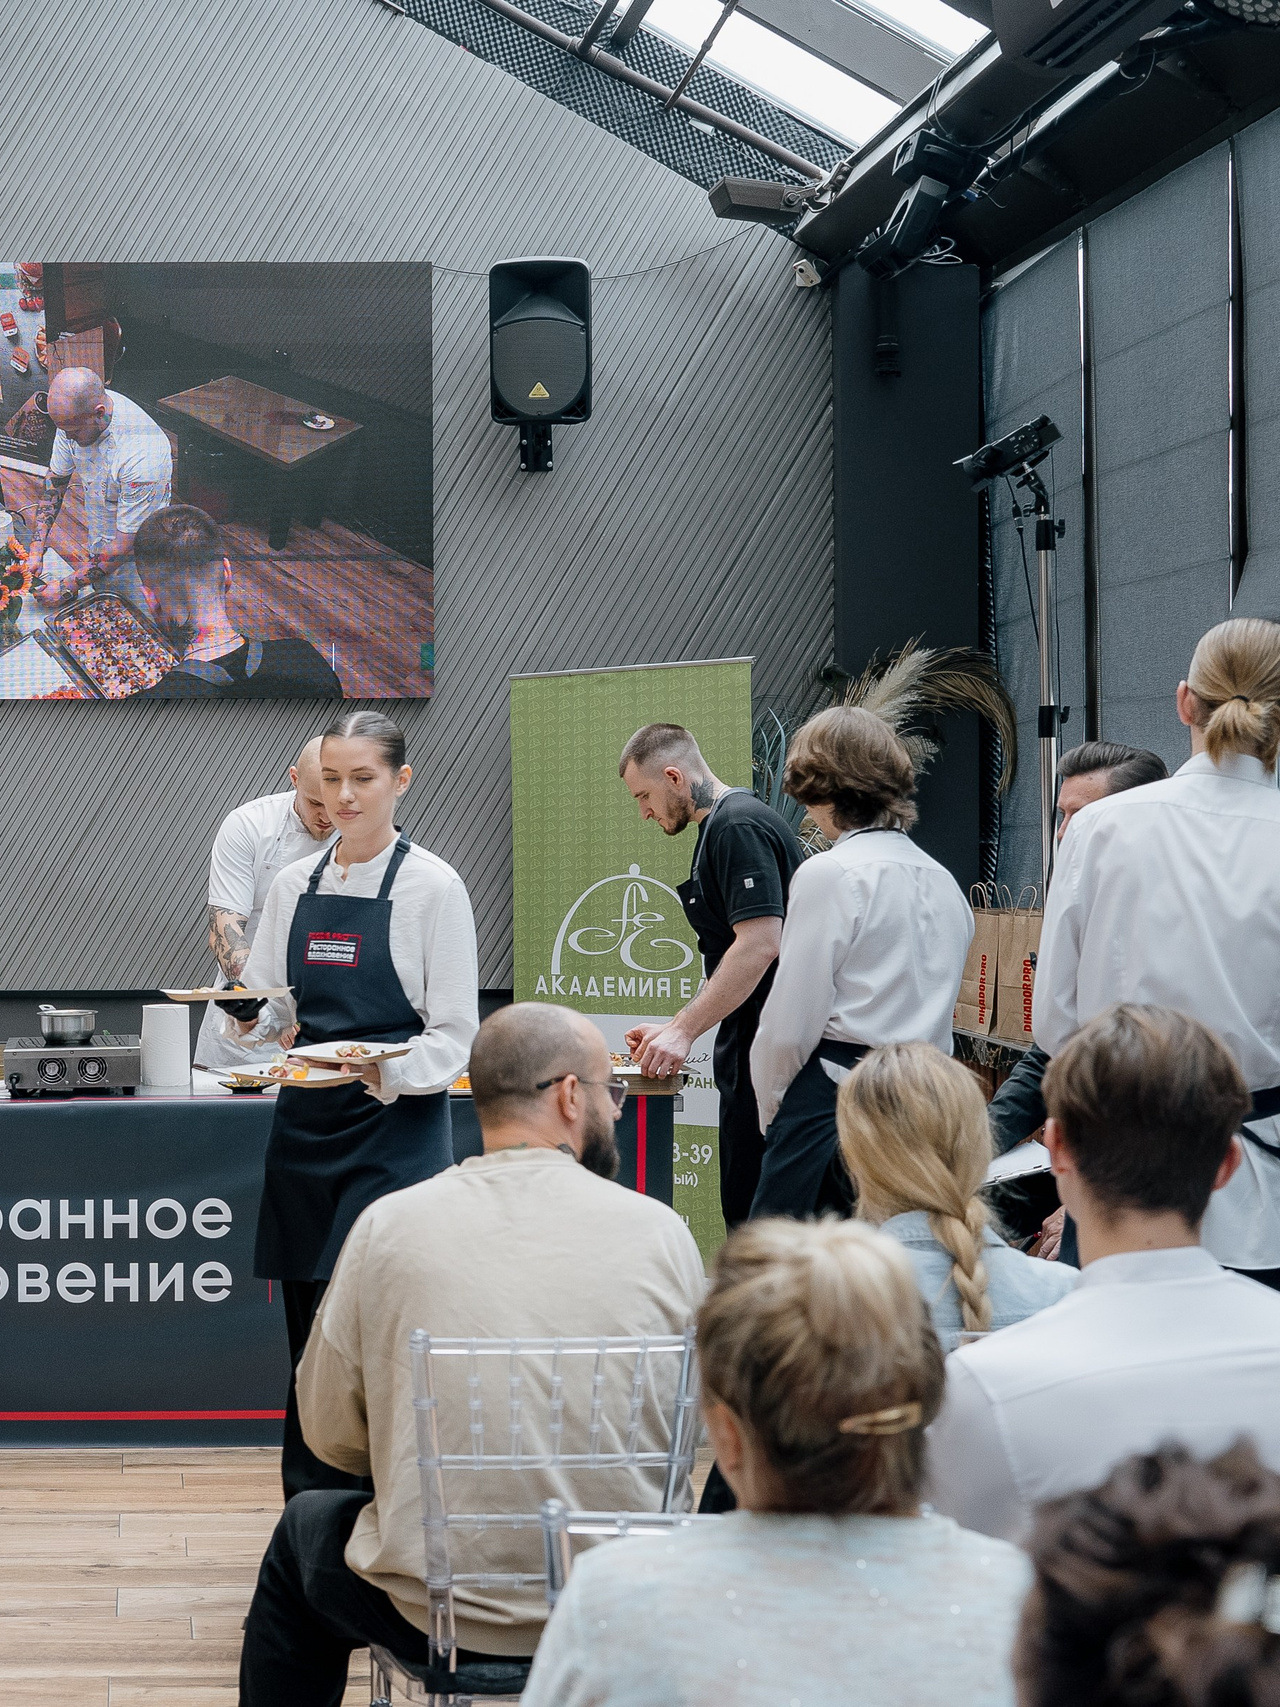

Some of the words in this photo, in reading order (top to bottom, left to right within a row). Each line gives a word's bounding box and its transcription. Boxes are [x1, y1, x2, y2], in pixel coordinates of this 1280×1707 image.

[535, 975, 671, 998] АКАДЕМИЯ
[1023, 959, 1032, 982] PRO
[978, 977, 986, 1024] PIKADOR
[1022, 982, 1033, 1032] PIKADOR
